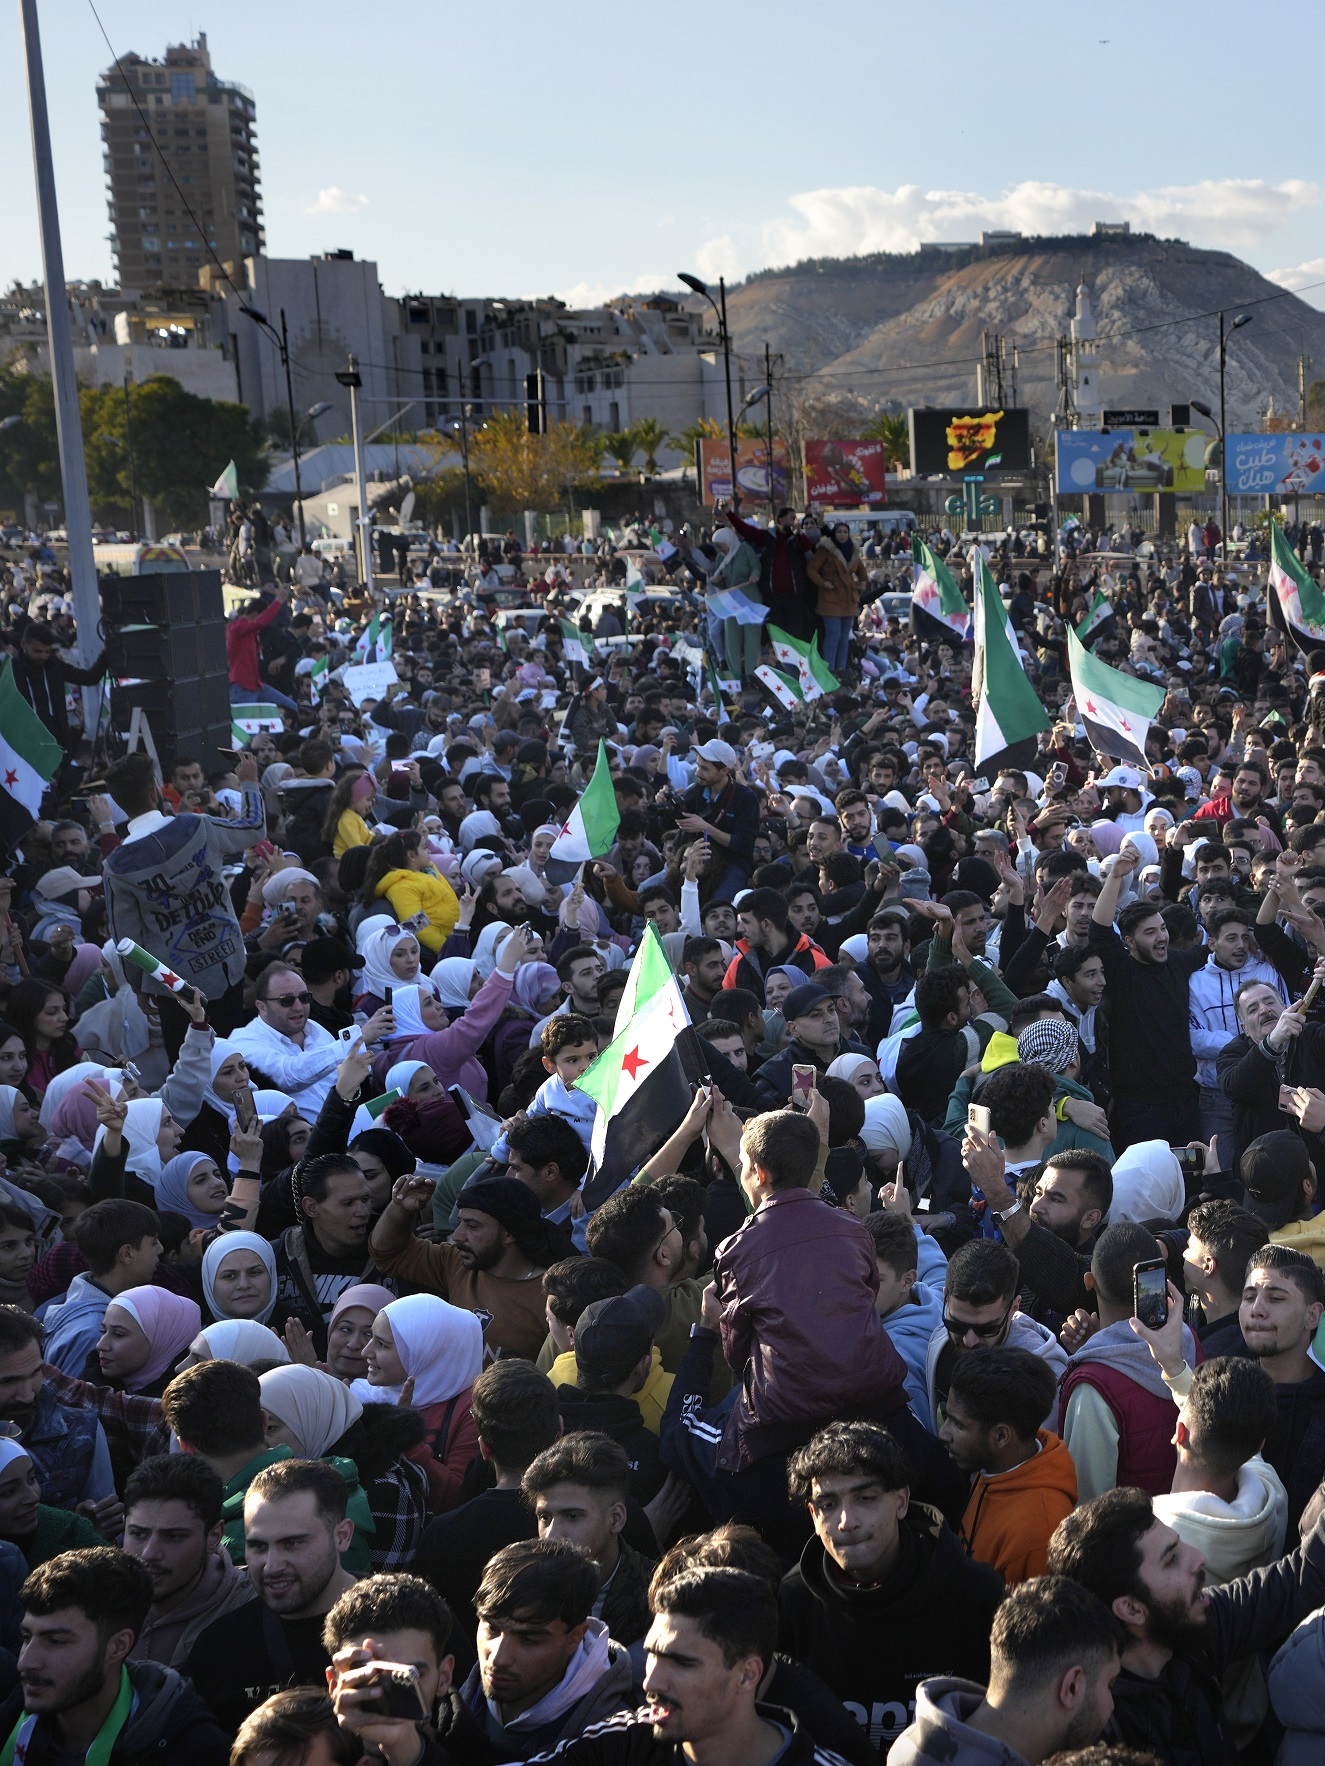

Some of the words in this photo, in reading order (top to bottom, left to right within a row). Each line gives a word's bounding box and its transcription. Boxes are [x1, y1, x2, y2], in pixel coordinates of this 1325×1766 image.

[1236, 449, 1276, 473] طيب
[1238, 469, 1275, 490] هيك
[945, 481, 1000, 520] ela
[194, 931, 217, 949] END
[195, 941, 234, 970] STREET
